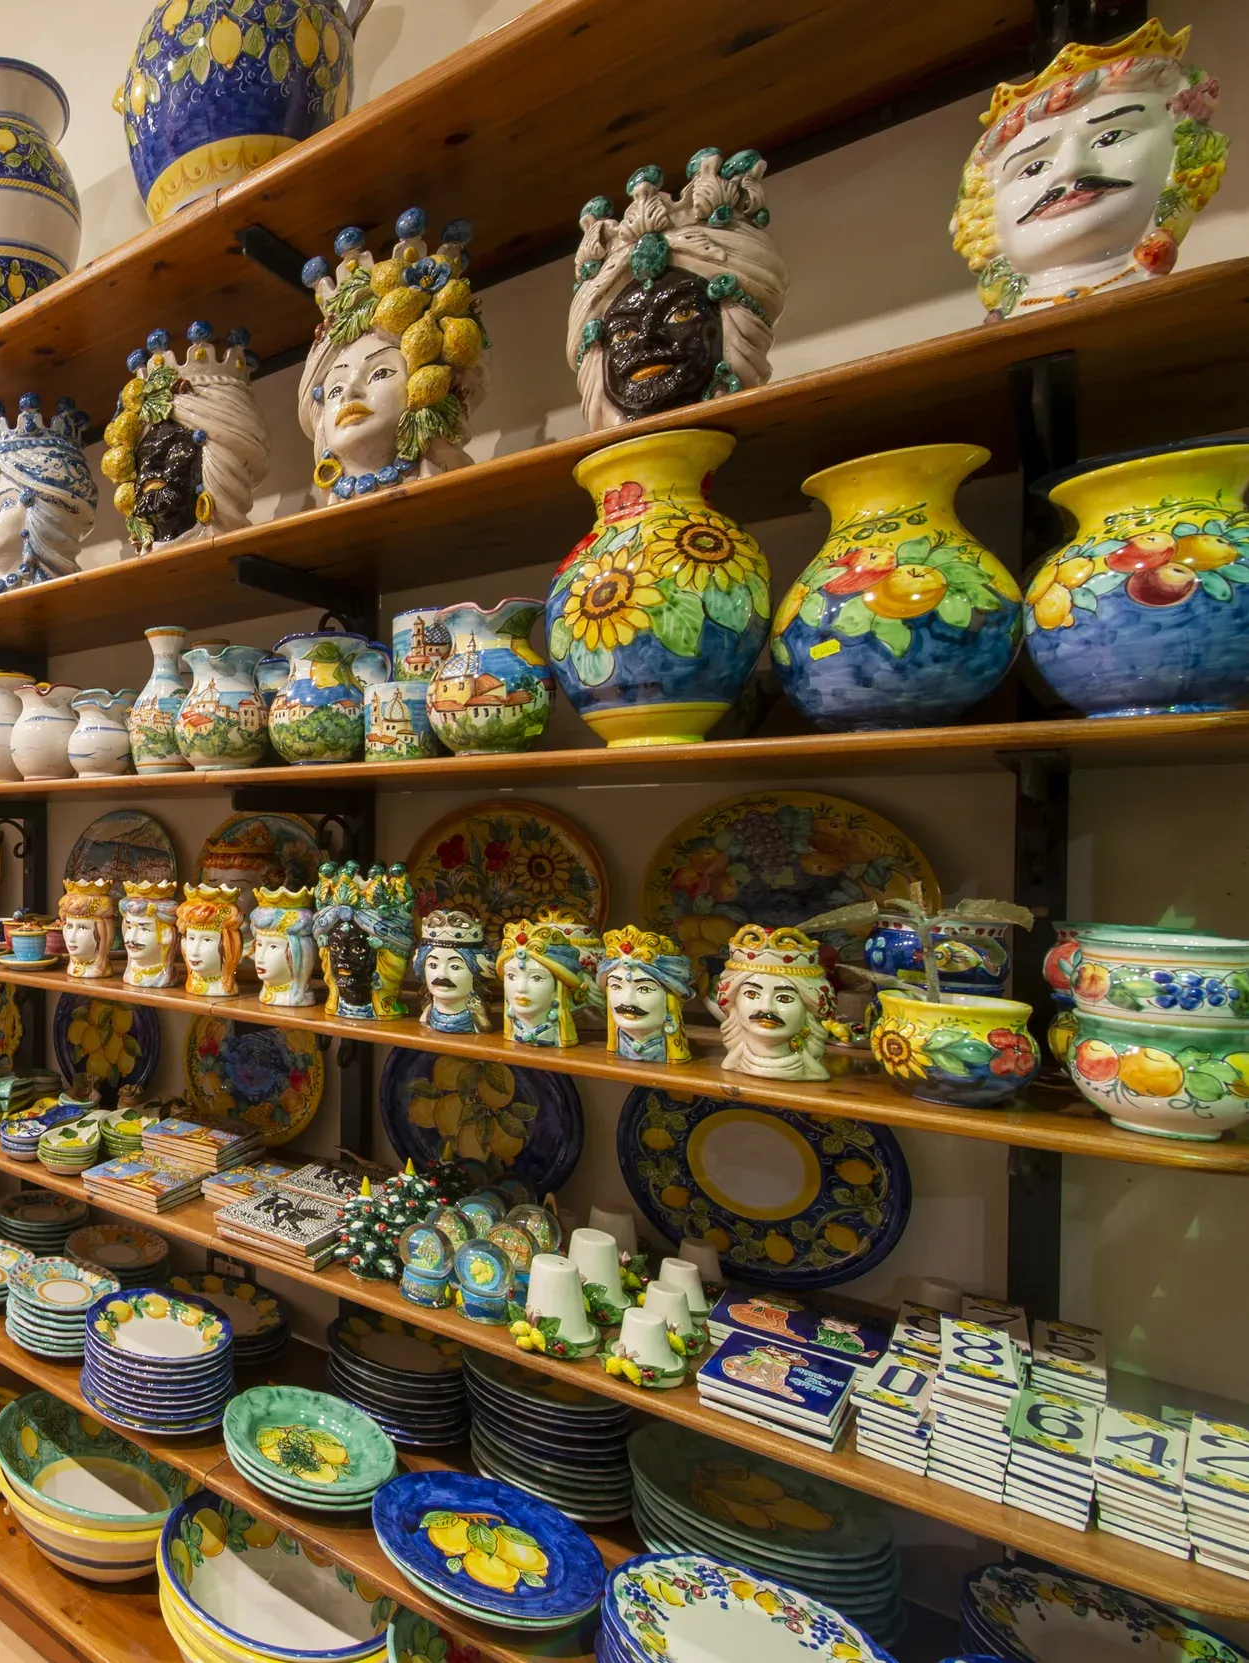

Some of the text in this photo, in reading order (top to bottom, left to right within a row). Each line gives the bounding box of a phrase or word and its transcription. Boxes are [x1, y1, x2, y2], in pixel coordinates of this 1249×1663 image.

[952, 1331, 1004, 1366] 8
[1043, 1329, 1097, 1363] 5
[1026, 1403, 1085, 1440] 6
[1105, 1431, 1178, 1471] 4
[1196, 1434, 1249, 1478] 2
